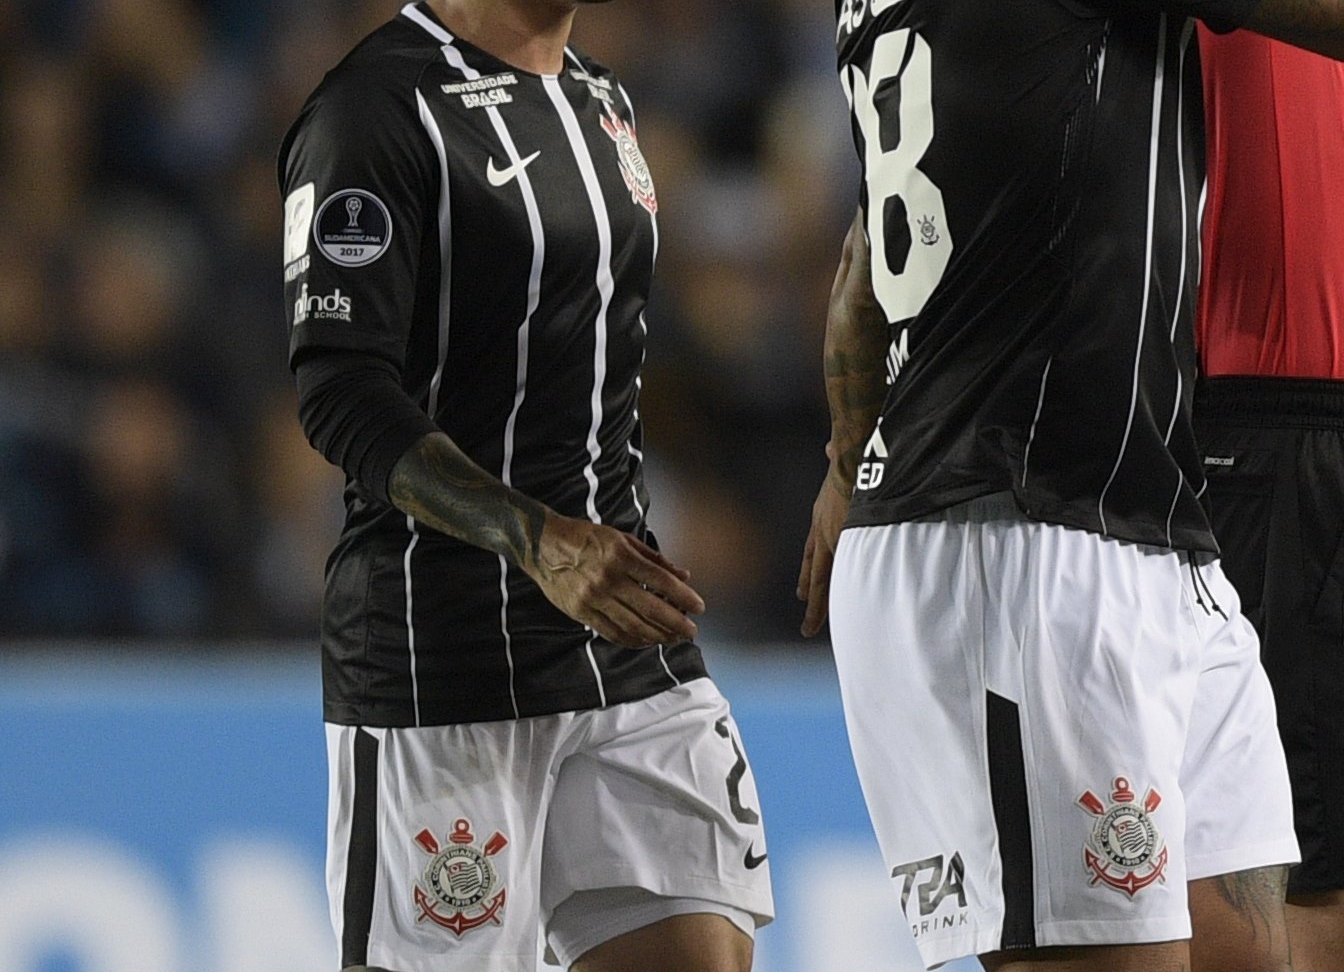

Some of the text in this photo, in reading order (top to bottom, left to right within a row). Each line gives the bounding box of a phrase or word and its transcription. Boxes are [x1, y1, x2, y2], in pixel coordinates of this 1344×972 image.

[440, 74, 518, 94] UNIVERSIDADE
[461, 88, 513, 108] BRASIL
[841, 27, 953, 324] 8
[340, 248, 364, 257] 2017
